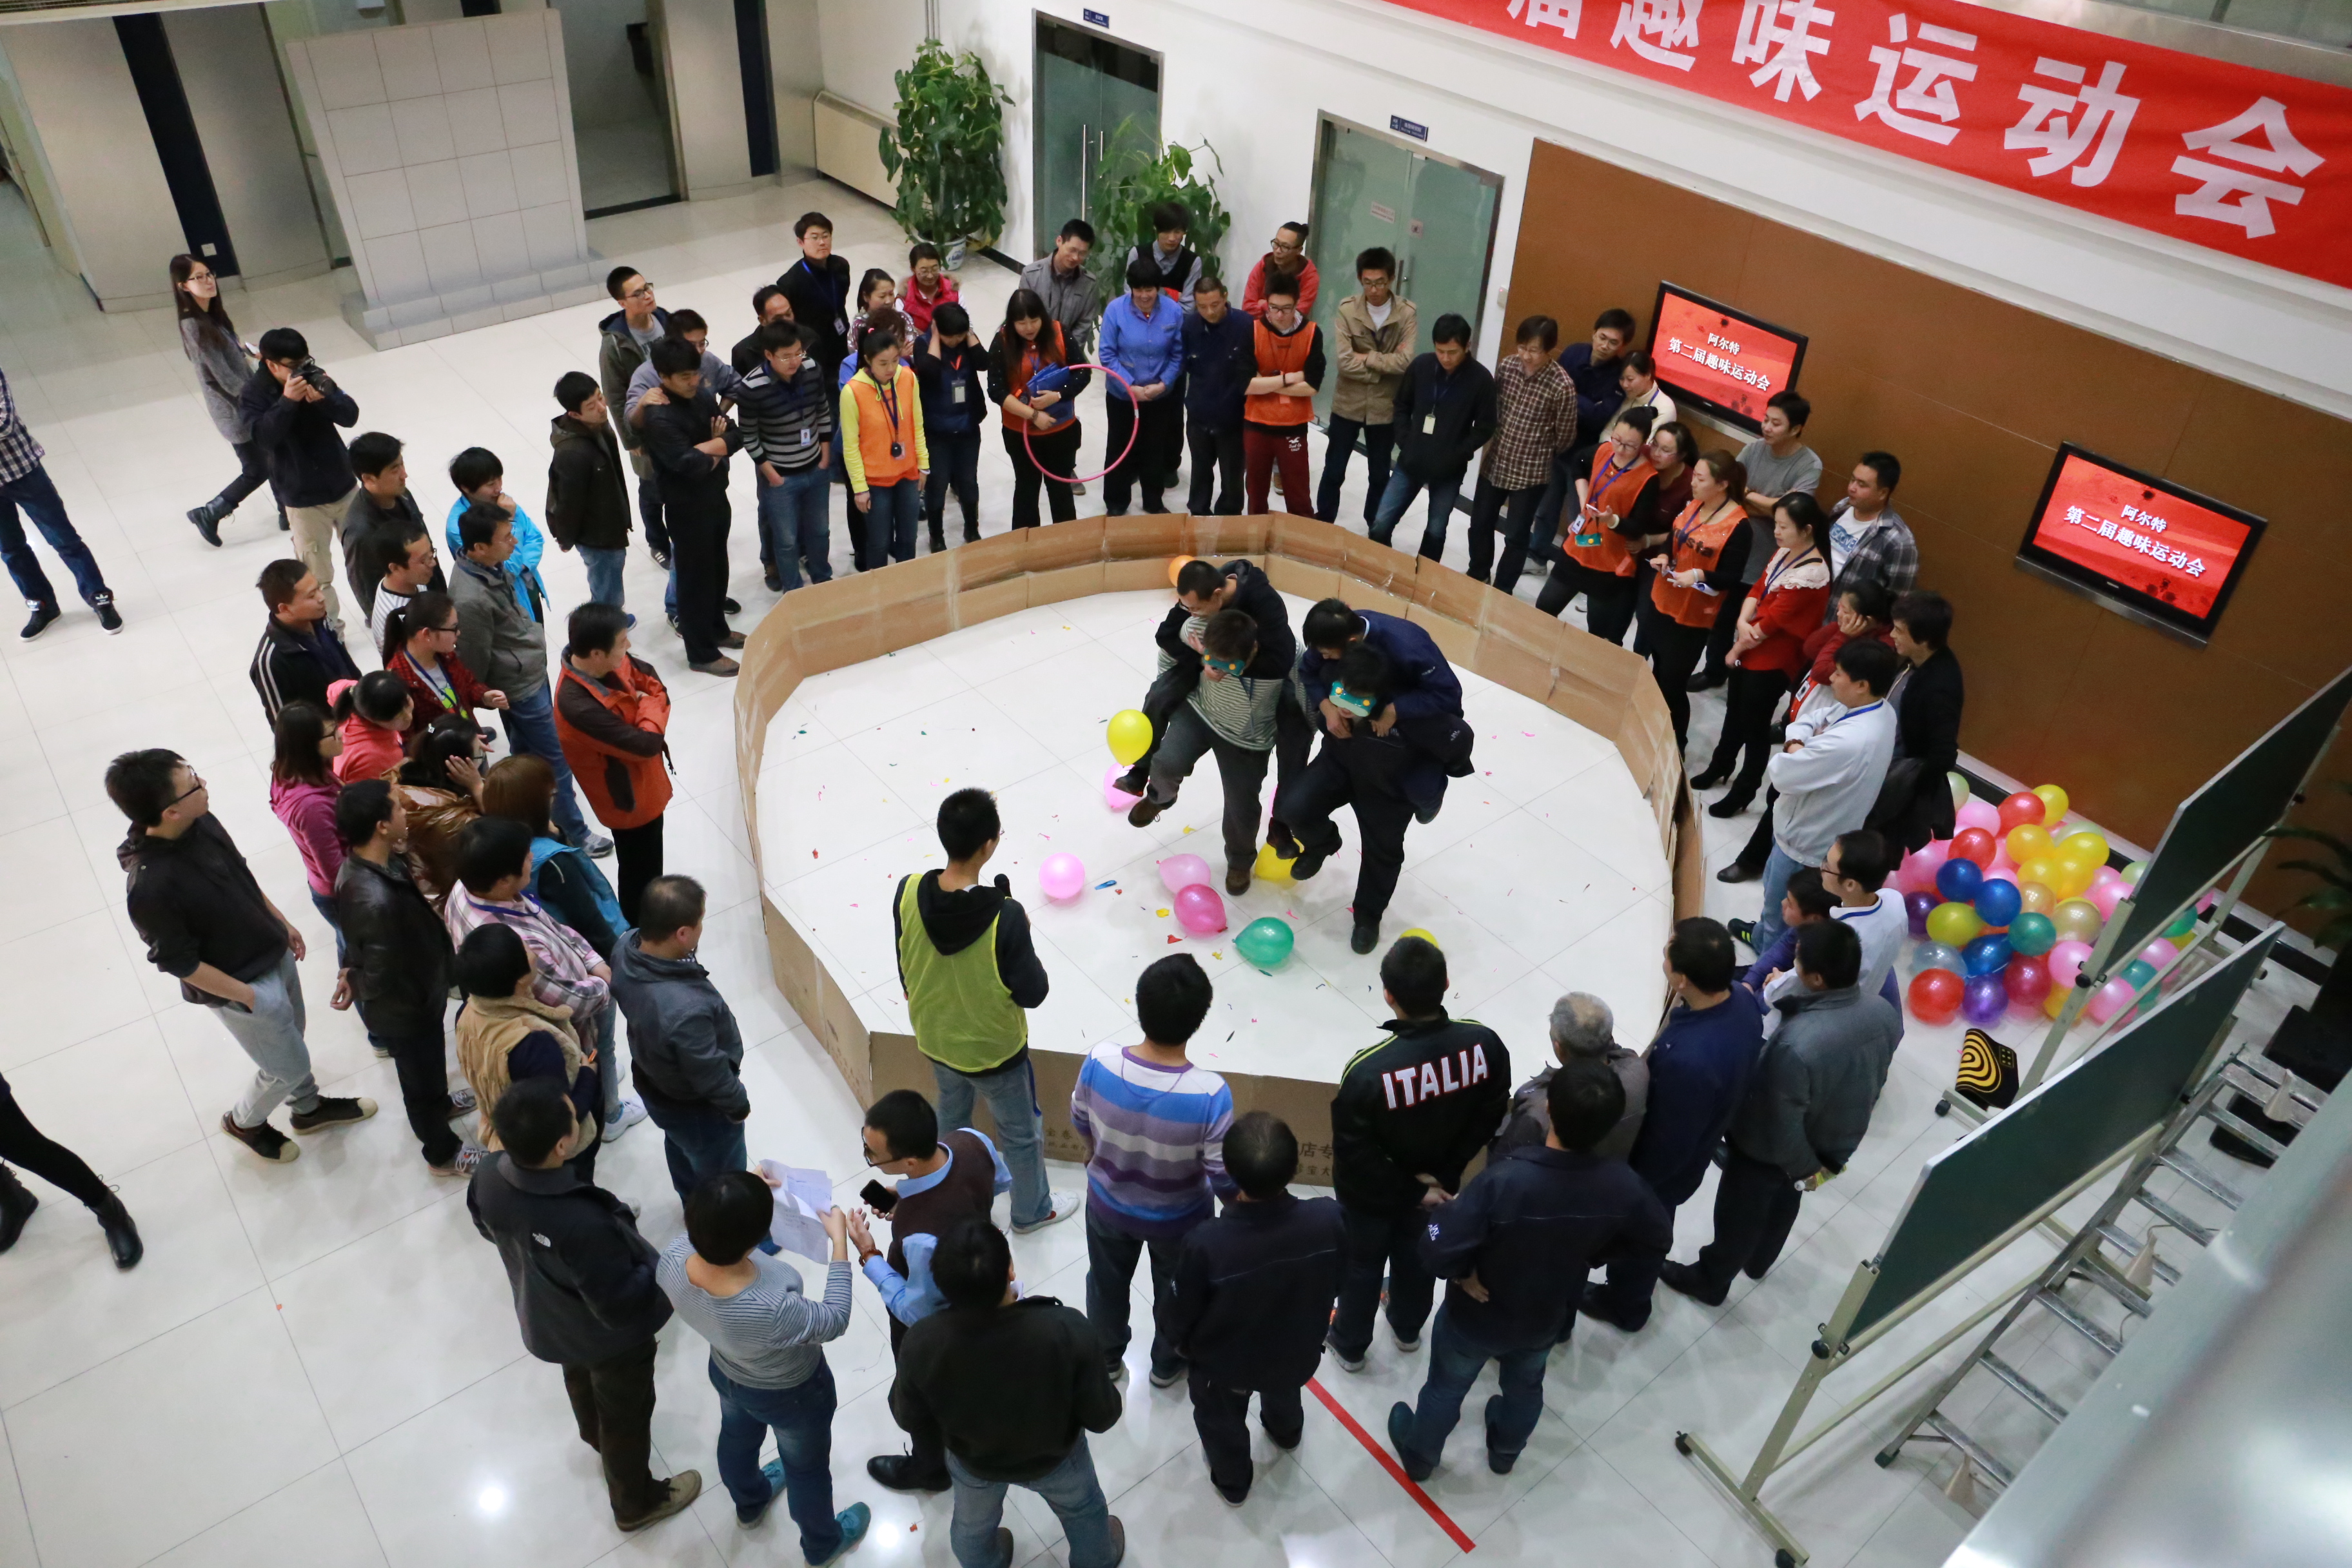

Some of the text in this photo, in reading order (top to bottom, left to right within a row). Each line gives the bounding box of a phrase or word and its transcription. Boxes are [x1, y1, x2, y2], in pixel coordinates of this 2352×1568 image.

[1668, 337, 1770, 391] 第二届趣味运动会
[1707, 333, 1740, 355] 阿尔特
[2121, 505, 2167, 533] 阿尔特
[2063, 505, 2206, 577] 第二届趣味运动会
[1382, 1043, 1488, 1110] ITALIA
[1297, 1142, 1333, 1159] 店专
